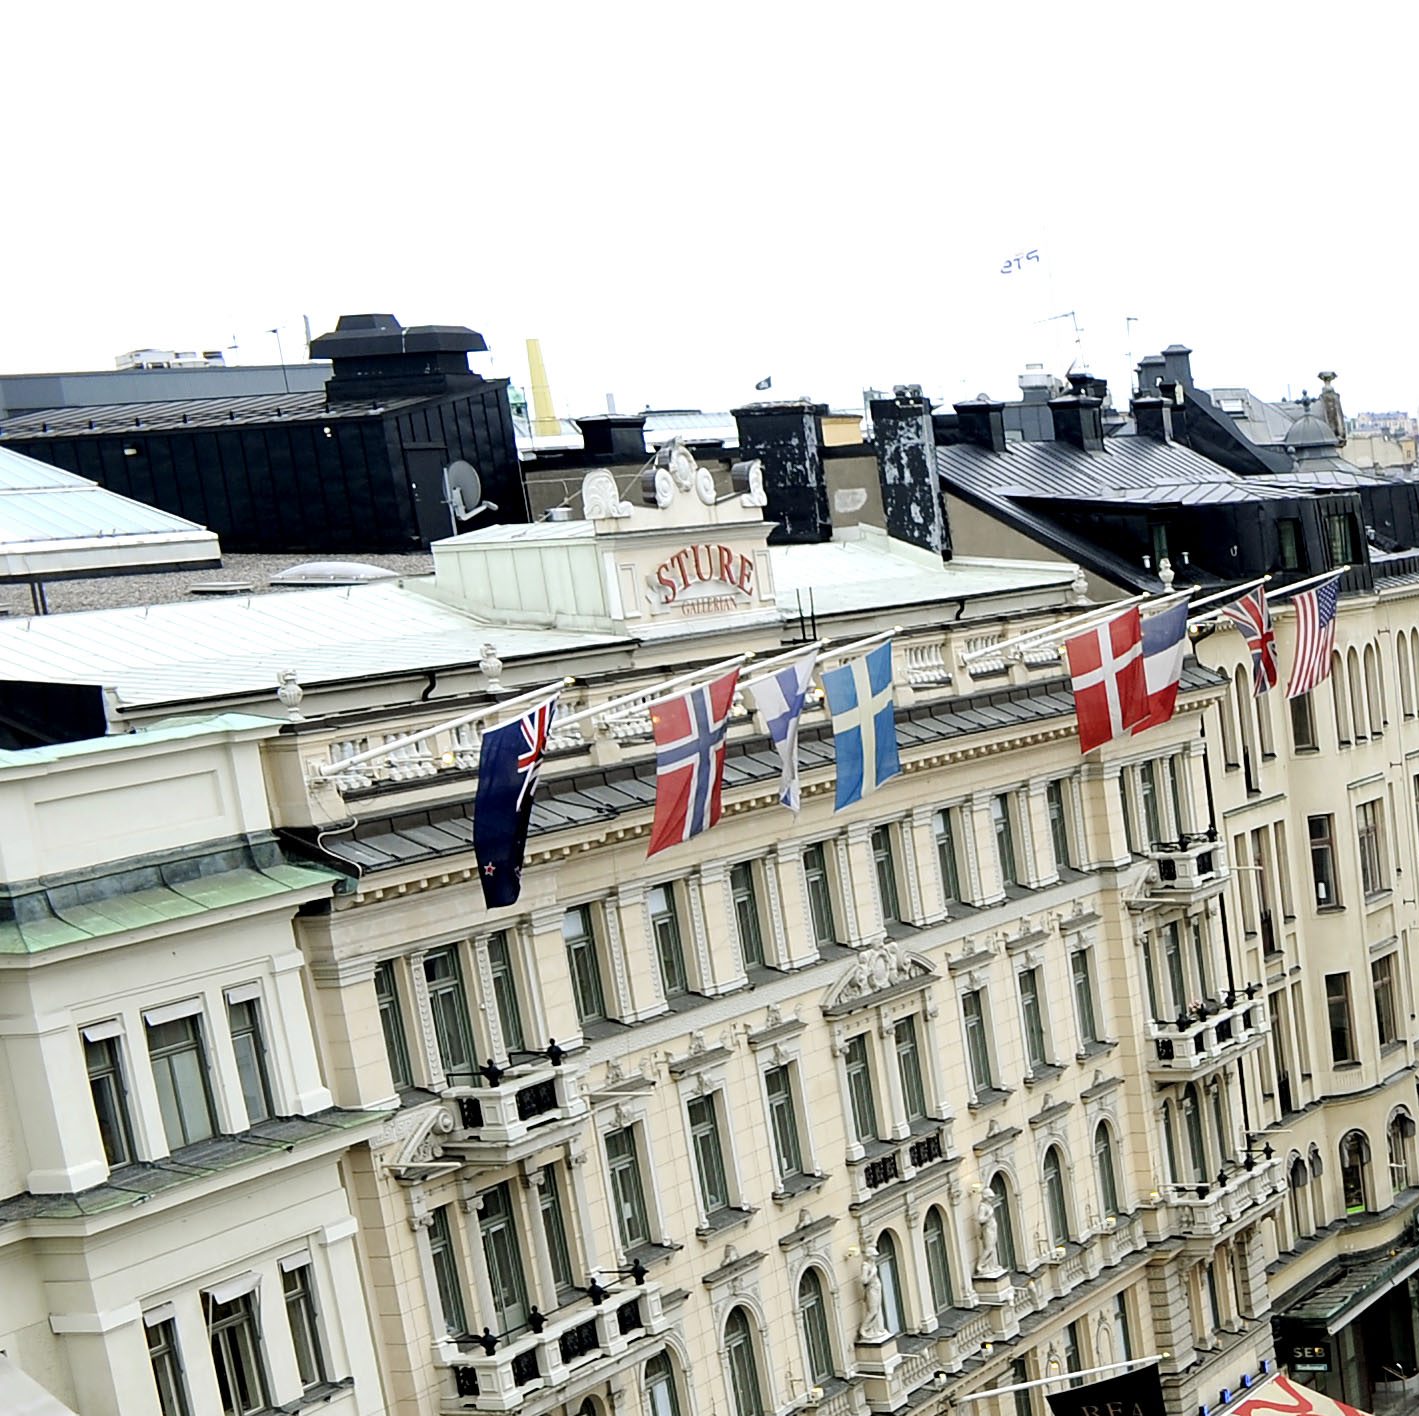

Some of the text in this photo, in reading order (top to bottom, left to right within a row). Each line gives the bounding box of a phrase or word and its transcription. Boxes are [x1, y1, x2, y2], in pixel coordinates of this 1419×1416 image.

[656, 543, 754, 605] STURE
[681, 596, 737, 616] GALLERIAN
[1293, 1346, 1326, 1359] SEB
